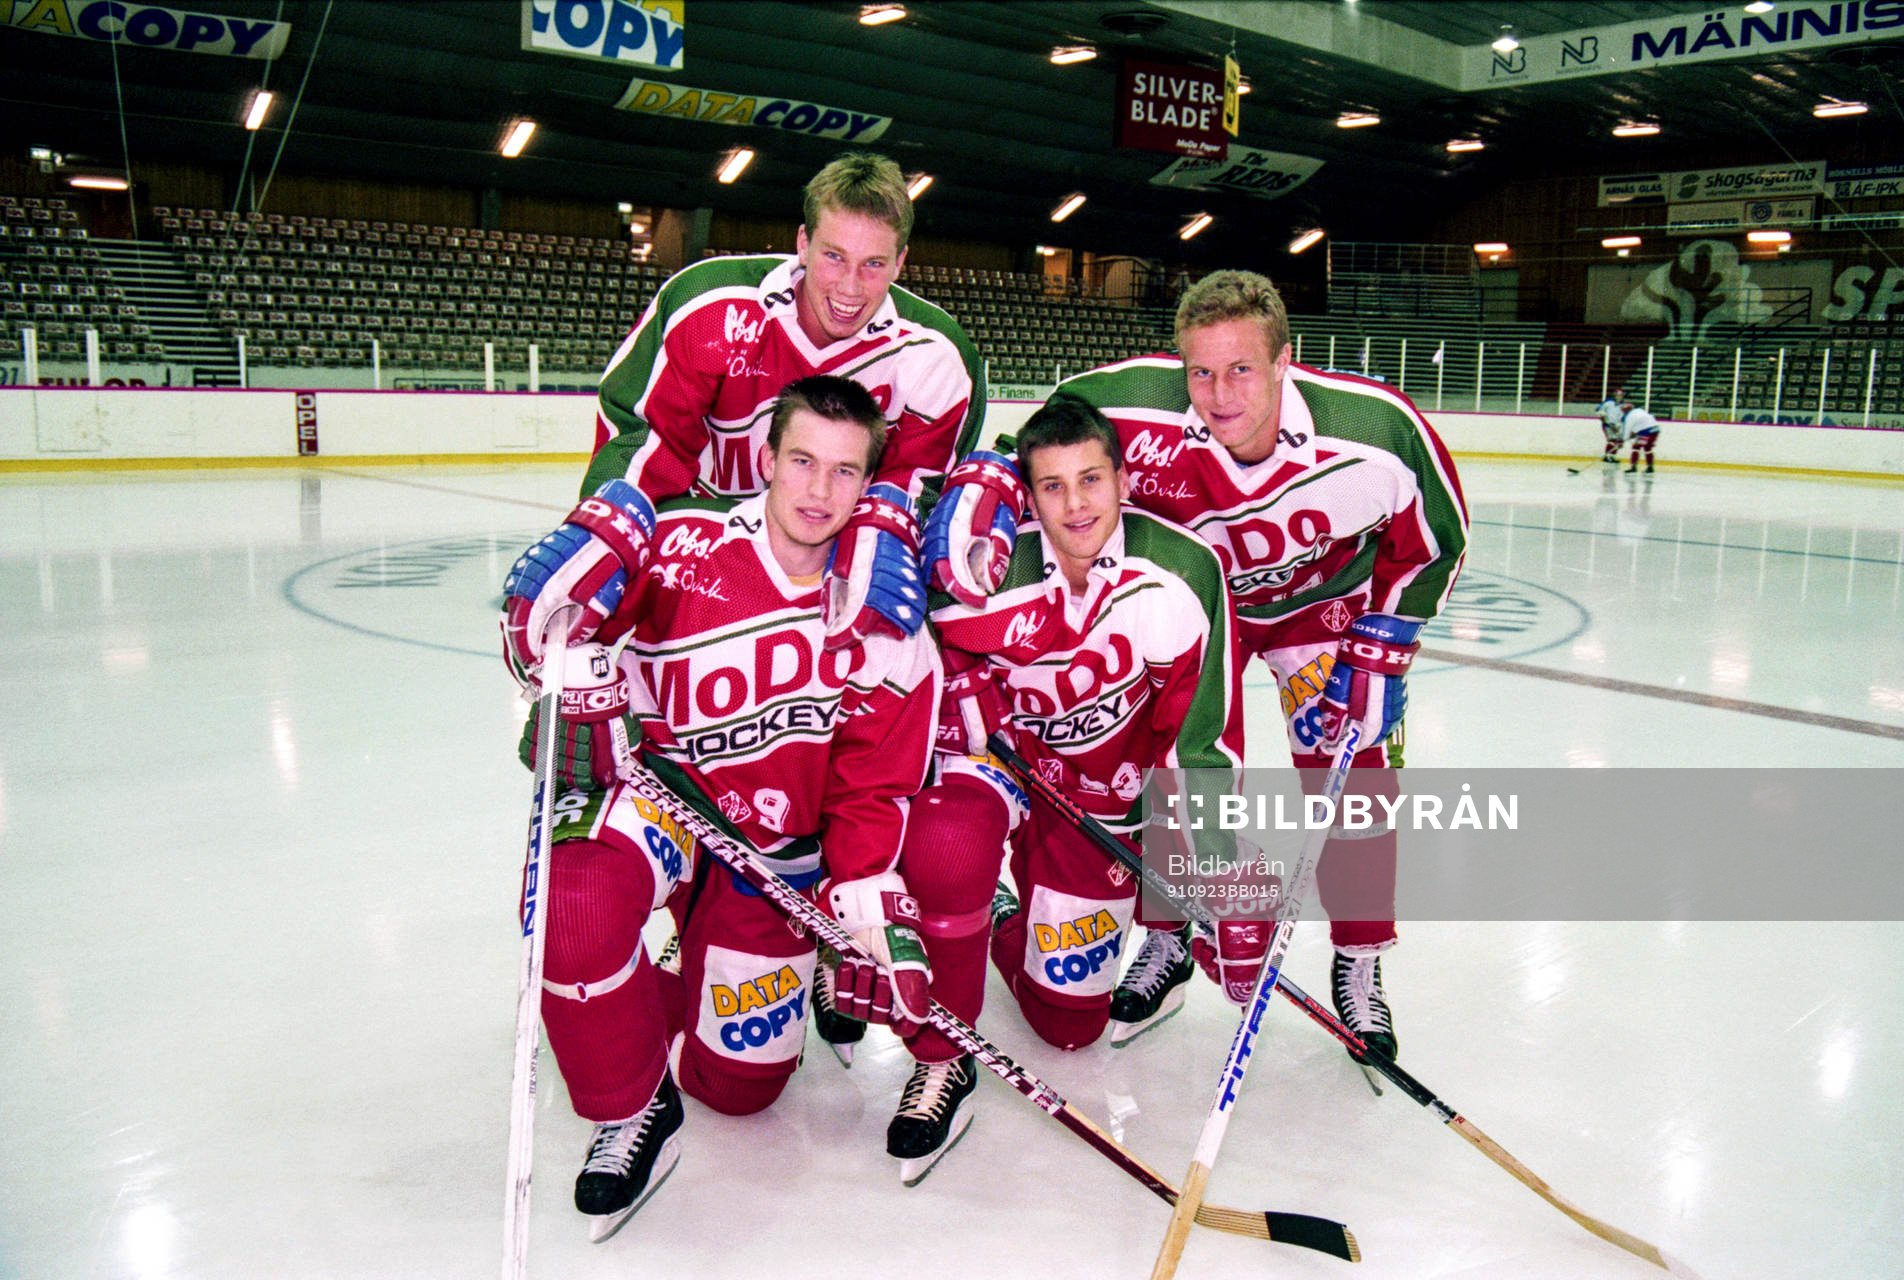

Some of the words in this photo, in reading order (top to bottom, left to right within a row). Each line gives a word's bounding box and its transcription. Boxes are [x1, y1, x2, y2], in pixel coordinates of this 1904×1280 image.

[1133, 72, 1223, 104] SILVER-
[1209, 164, 1301, 191] REDS
[999, 388, 1036, 402] Finans
[296, 393, 318, 456] OPEL
[660, 524, 724, 560] Obs!
[640, 628, 867, 727] MoDo
[523, 780, 546, 938] TITAN
[1034, 908, 1119, 953] DATA
[1044, 931, 1123, 986] COPY
[711, 964, 802, 1018] DATA
[720, 987, 806, 1052] COPY
[1219, 965, 1279, 1112] TITAN
